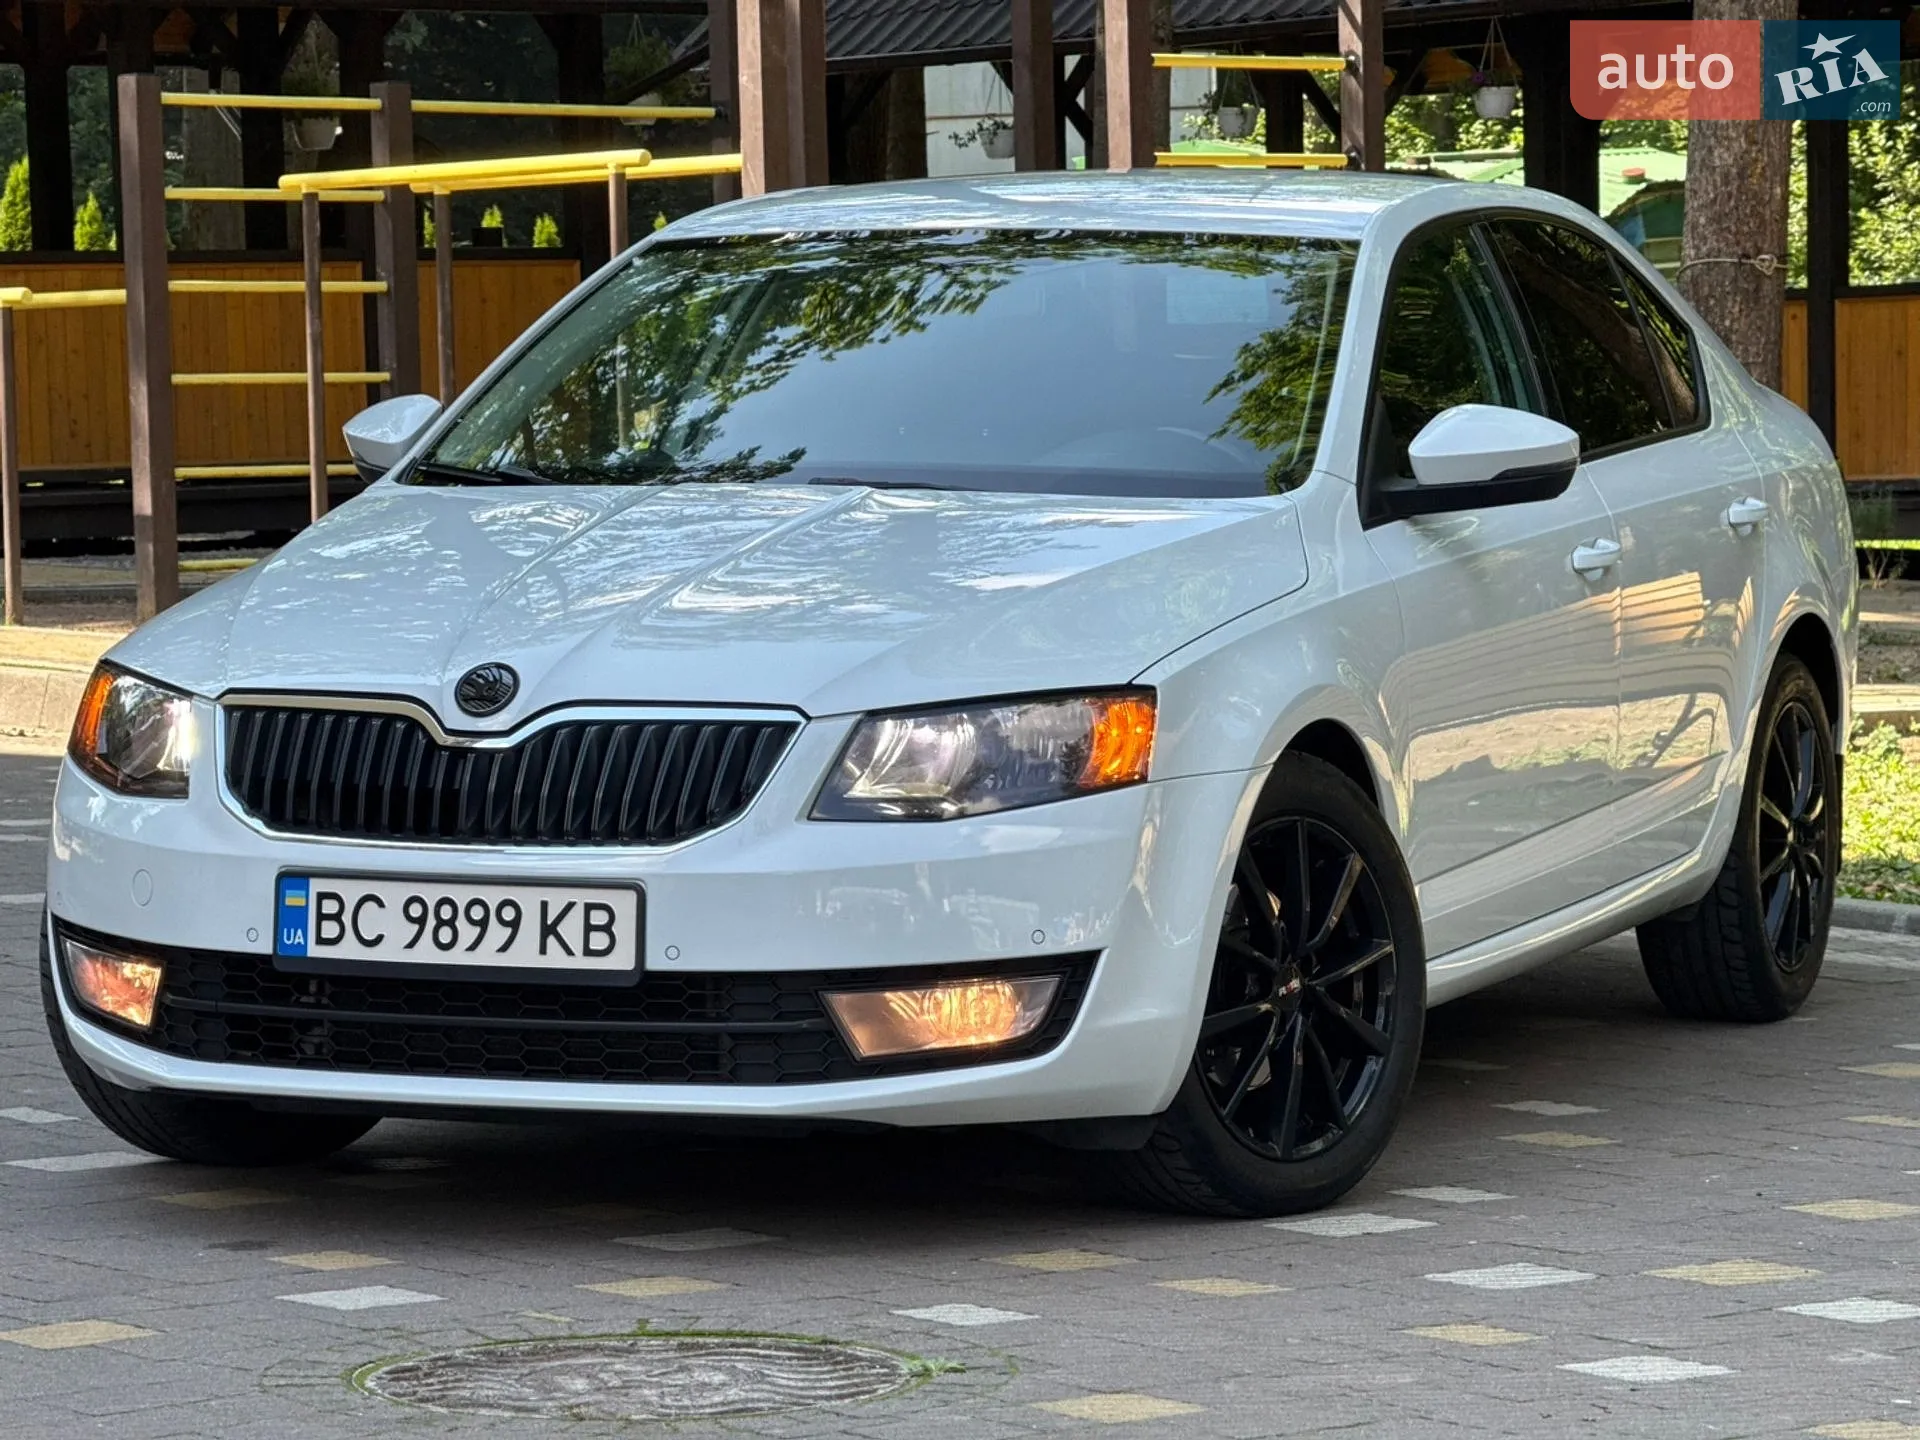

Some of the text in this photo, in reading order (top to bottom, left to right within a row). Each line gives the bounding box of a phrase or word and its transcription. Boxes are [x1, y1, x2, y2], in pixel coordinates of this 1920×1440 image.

[283, 927, 305, 945] UA
[315, 891, 617, 957] BC 9899 KB
